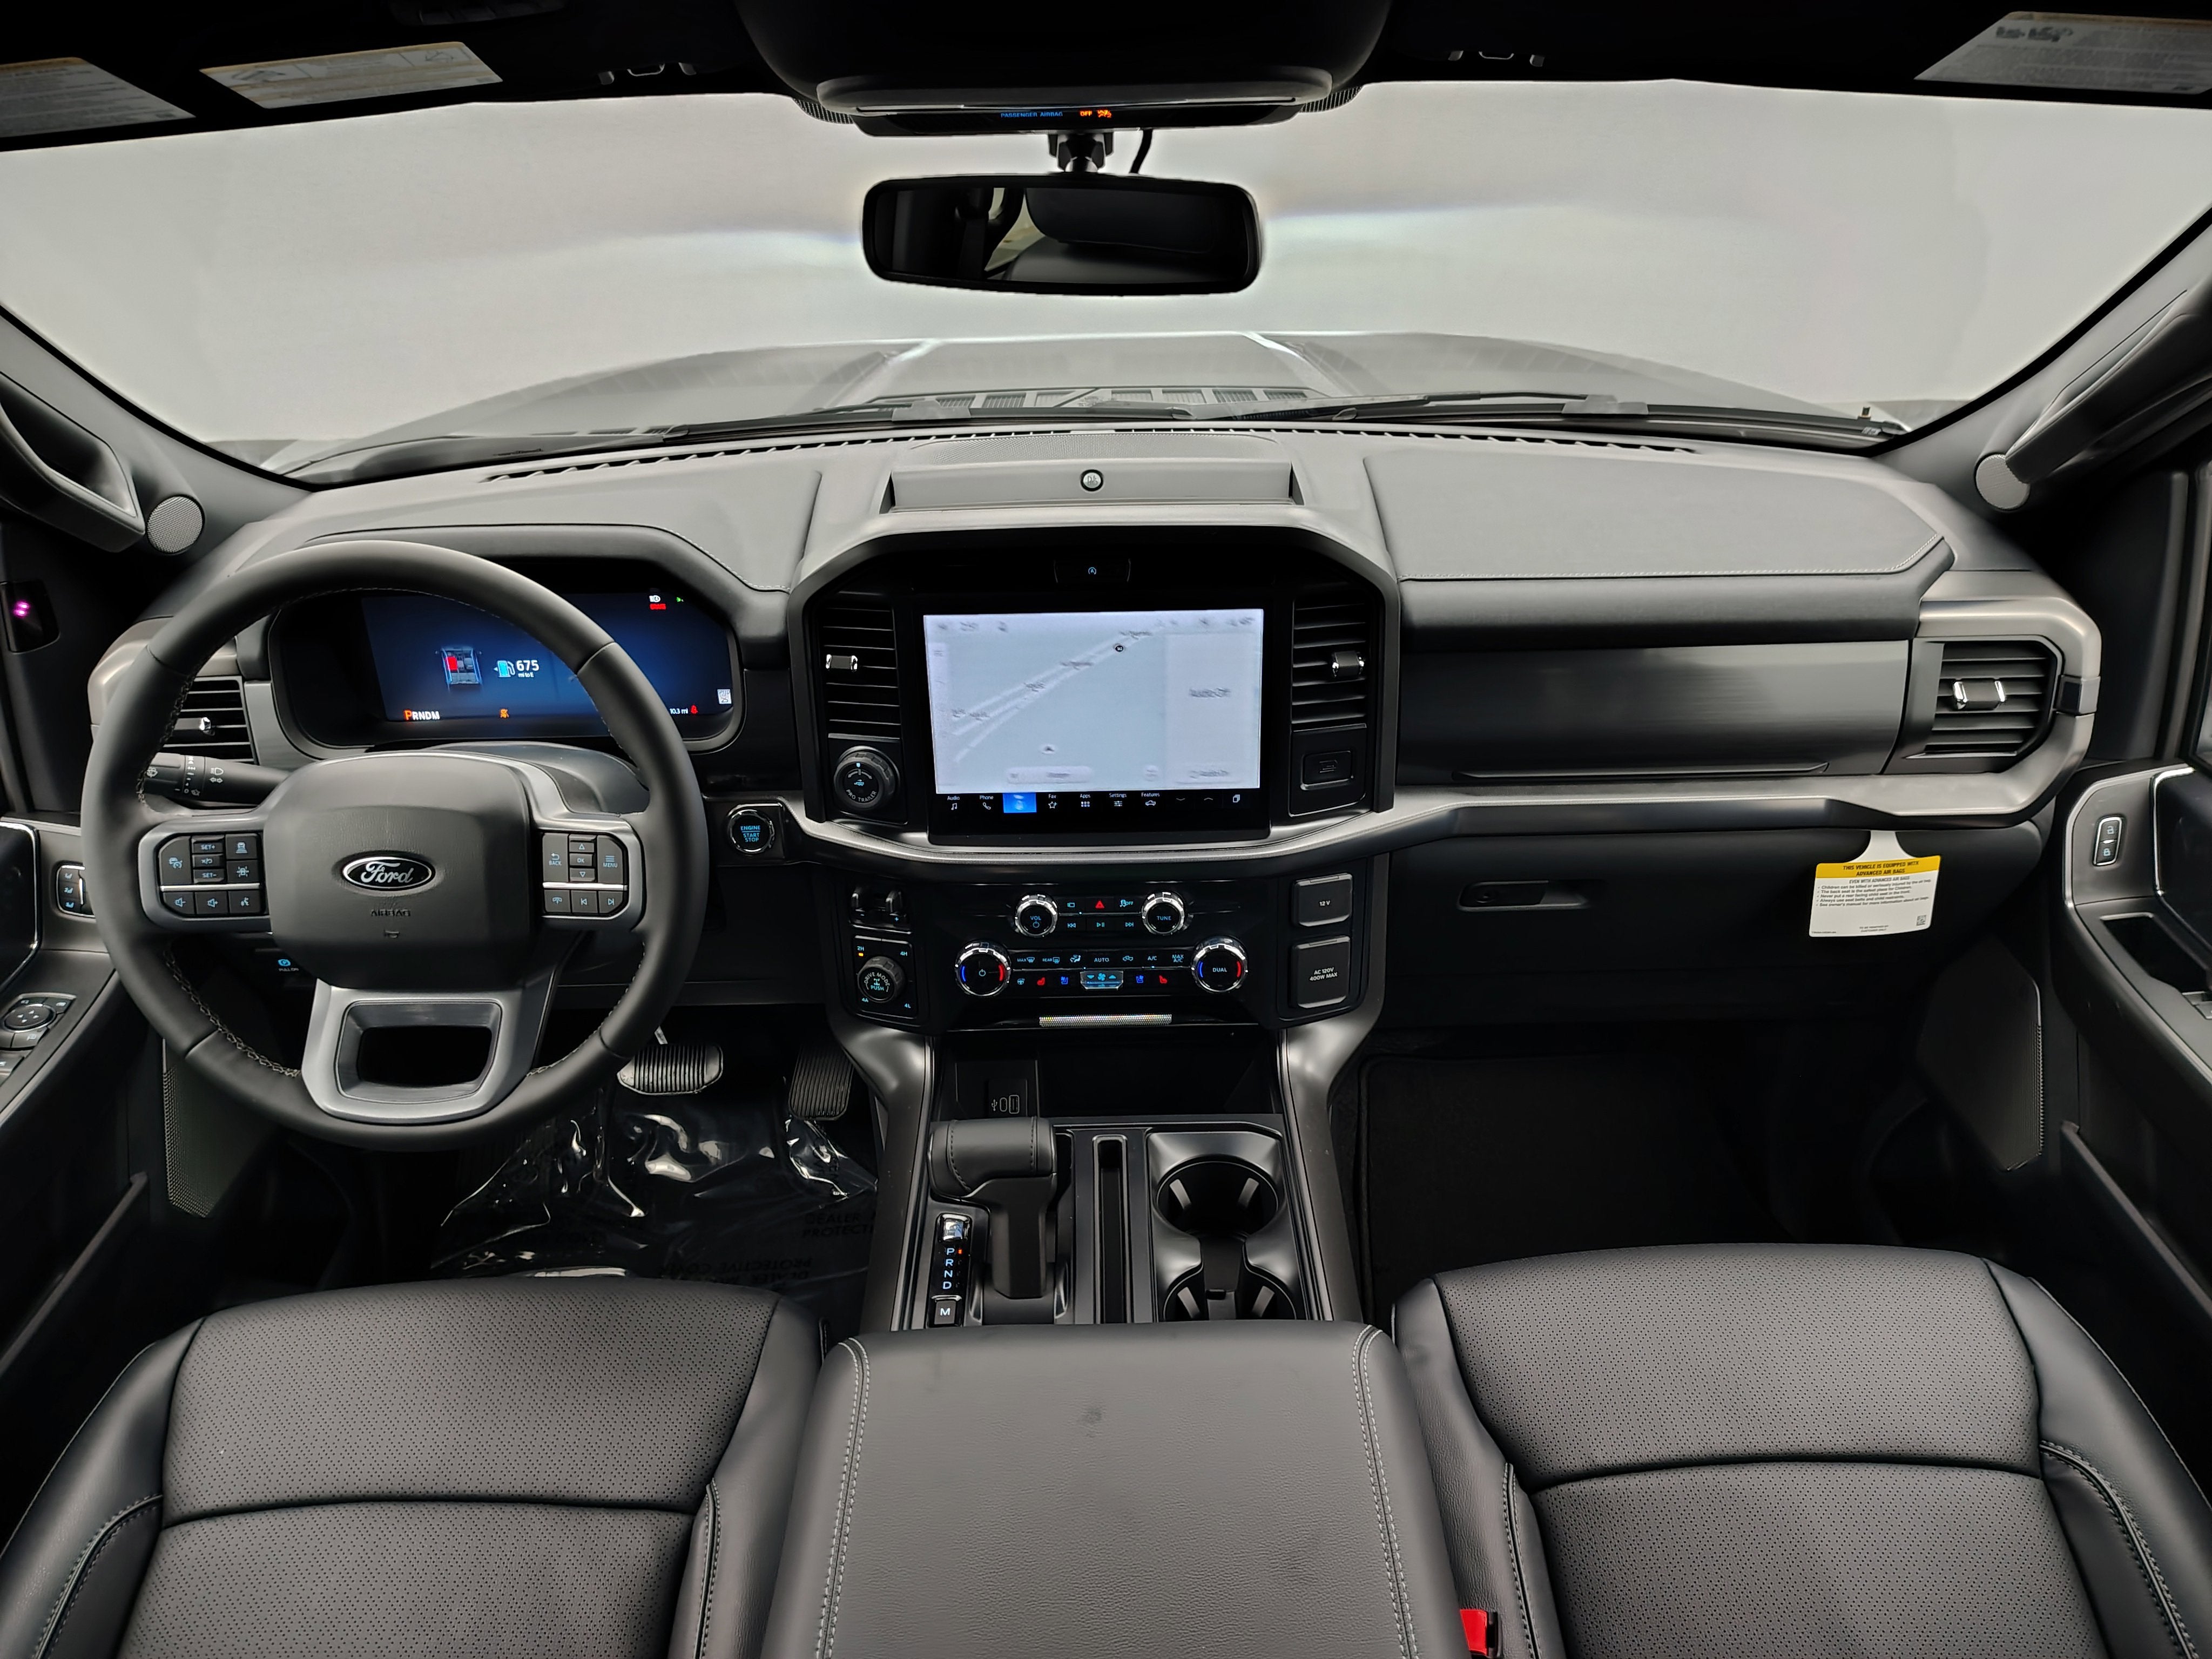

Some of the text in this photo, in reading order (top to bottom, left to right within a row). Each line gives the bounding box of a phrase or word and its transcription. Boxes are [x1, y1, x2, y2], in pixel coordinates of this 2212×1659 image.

[516, 660, 539, 671] 675
[846, 789, 877, 802] PRO TRAILER
[360, 860, 414, 884] Ford
[371, 909, 412, 917] AIRBAG
[864, 972, 891, 986] DRIVE MODE
[945, 1270, 953, 1278] N
[942, 1281, 952, 1290] D
[940, 1307, 951, 1316] M
